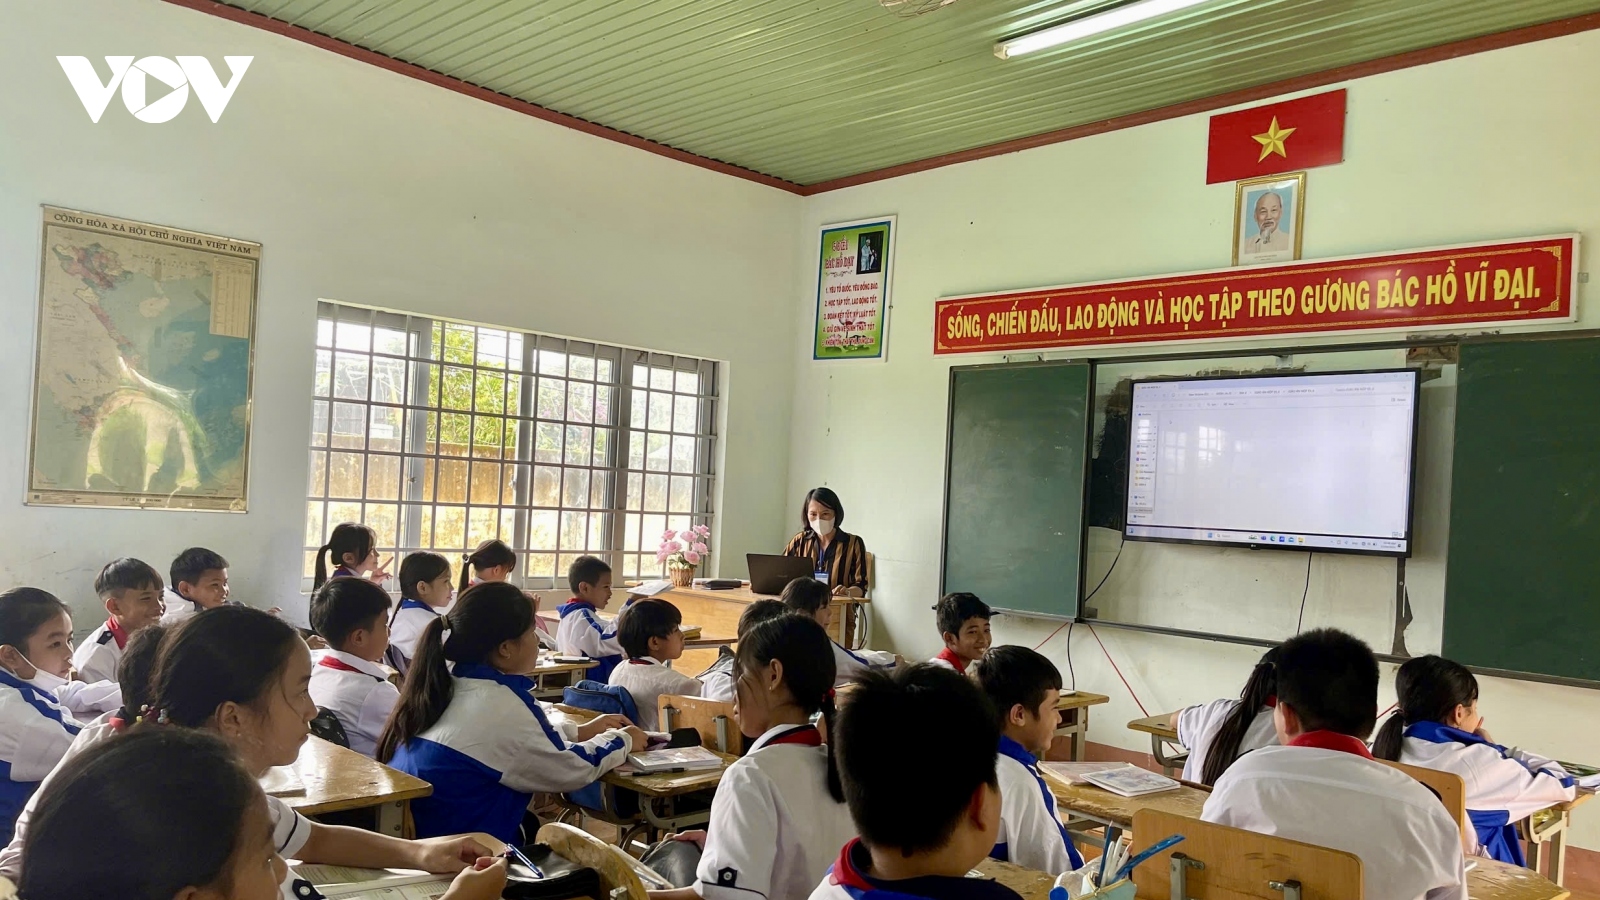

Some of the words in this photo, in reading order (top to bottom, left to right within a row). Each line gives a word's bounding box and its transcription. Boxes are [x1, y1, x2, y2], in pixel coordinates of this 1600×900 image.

[54, 213, 83, 224] CỘNG
[129, 226, 146, 236] HỘI
[149, 230, 169, 239] CHỦ
[172, 234, 202, 246] NGHĨA
[206, 240, 227, 250] VIỆT
[230, 244, 251, 254] NAM
[947, 306, 984, 342] SỐNG,
[987, 300, 1027, 336] CHIẾN
[1030, 298, 1062, 336] ĐẤU,
[1066, 304, 1094, 331] LAO
[1097, 296, 1139, 335] ĐỘNG
[1144, 291, 1165, 325] VÀ
[1169, 295, 1204, 330] HỌC
[1209, 286, 1242, 328] TẬP
[1247, 287, 1296, 318] THEO
[1301, 277, 1370, 315] GƯƠNG
[1376, 269, 1420, 309] BÁC
[1426, 260, 1458, 306] HỒ
[1465, 261, 1490, 303] VĨ
[1493, 266, 1541, 309] ĐẠI.
